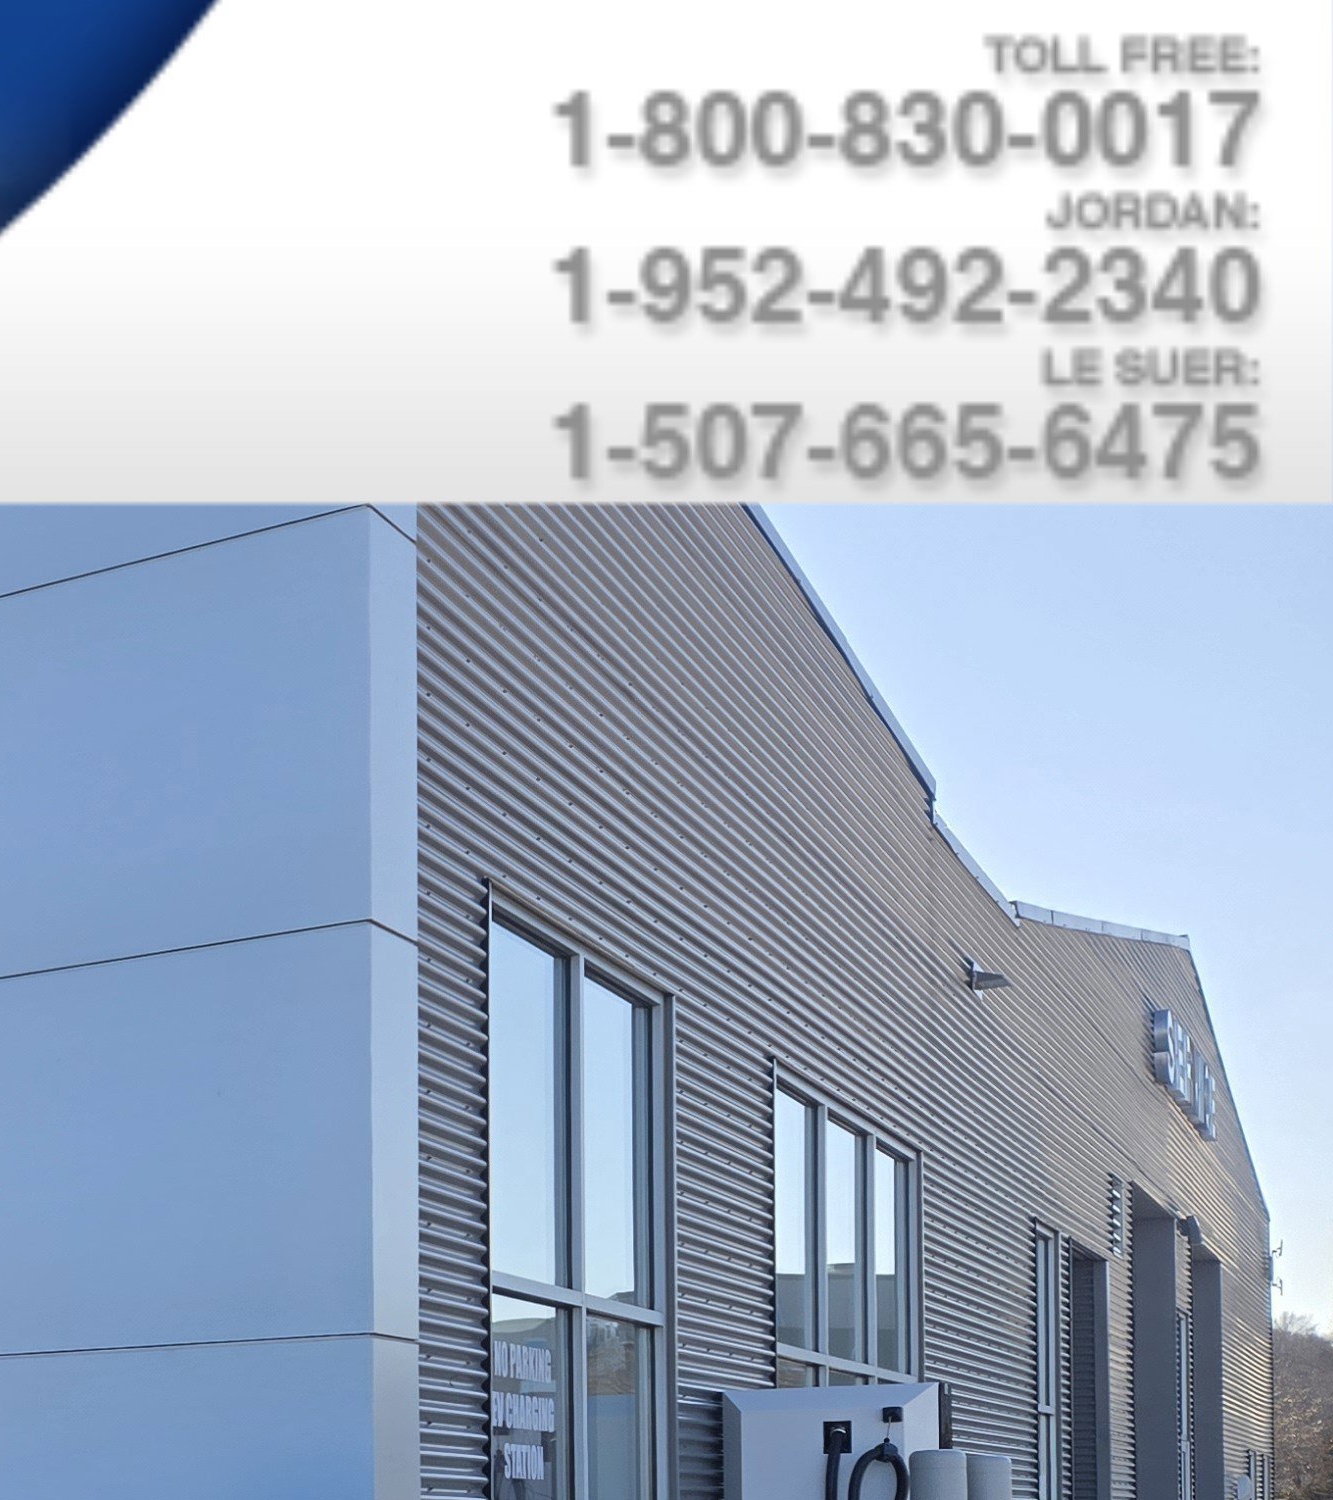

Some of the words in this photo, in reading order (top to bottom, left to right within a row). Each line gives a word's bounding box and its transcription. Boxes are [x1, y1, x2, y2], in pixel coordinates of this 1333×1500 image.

[493, 1340, 508, 1378] NO
[510, 1343, 552, 1384] PARKING
[491, 1391, 504, 1427] EV
[505, 1392, 555, 1433] CHARGING
[503, 1443, 545, 1481] STATION
